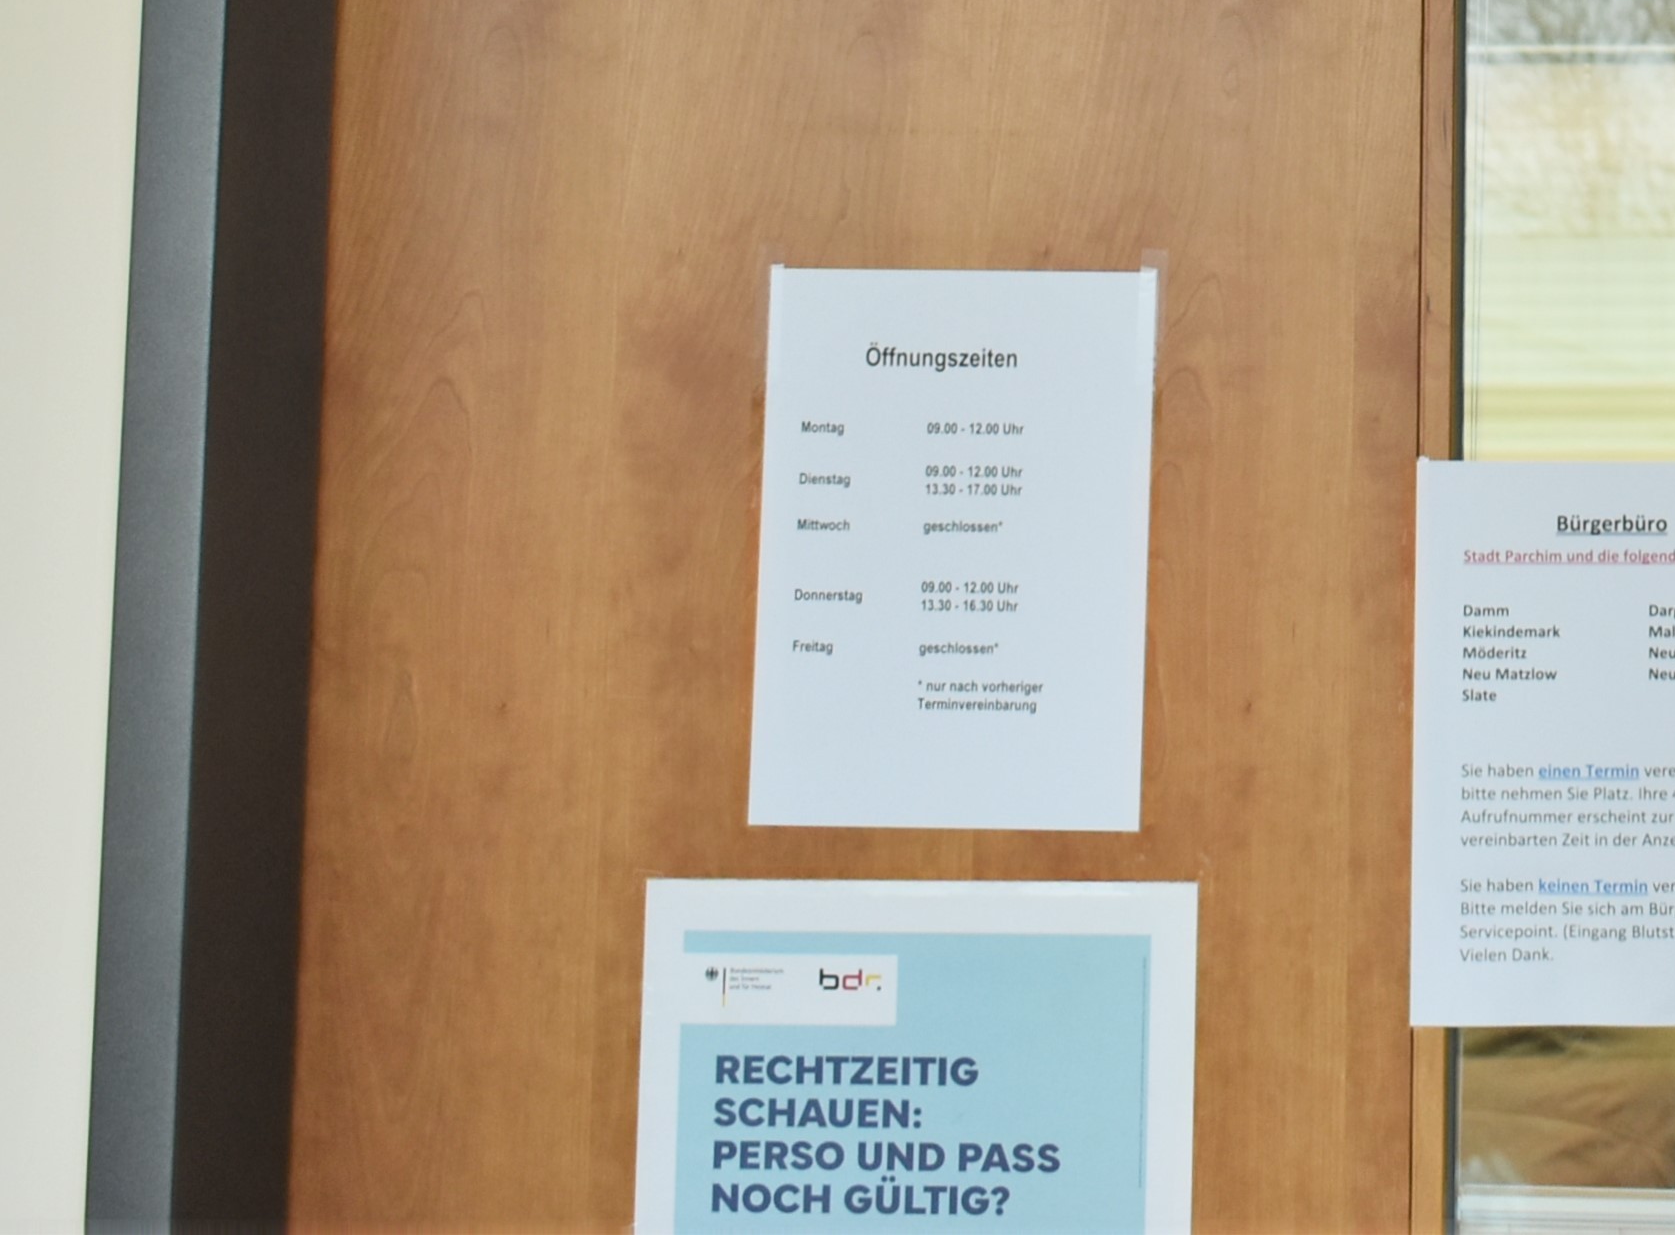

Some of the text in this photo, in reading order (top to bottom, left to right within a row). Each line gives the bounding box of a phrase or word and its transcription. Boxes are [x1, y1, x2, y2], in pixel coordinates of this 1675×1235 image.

[865, 342, 1017, 371] Öffnungszeiten
[801, 421, 844, 436] Montag
[927, 422, 958, 434] 09.00
[970, 423, 999, 435] 12.00
[1003, 423, 1024, 435] Uhr
[925, 465, 956, 477] 09.00
[968, 466, 998, 478] 12.00
[1001, 466, 1022, 478] Uhr
[799, 472, 851, 488] Dienstag
[926, 483, 956, 495] 13.30
[967, 484, 997, 496] 17.00
[1001, 484, 1022, 496] Uhr
[797, 519, 850, 531] Mittwoch
[1556, 514, 1667, 536] Bürgerbüro
[1463, 549, 1501, 565] Stadt
[1505, 549, 1563, 565] Parchim
[1566, 549, 1594, 565] und
[1597, 549, 1620, 565] die
[921, 581, 952, 593] 09.00
[964, 582, 994, 594] 12.00
[998, 582, 1019, 594] Uhr
[794, 588, 863, 604] Donnerstag
[921, 599, 952, 611] 13.30
[963, 600, 993, 612] 16.30
[997, 600, 1018, 612] Uhr
[1463, 604, 1509, 617] Damm
[1463, 625, 1560, 639] Kiekindemark
[792, 640, 833, 656] Freitag
[1463, 646, 1526, 660] Möderitz
[1463, 667, 1557, 681] Neu Matzlow
[926, 682, 946, 692] nur
[950, 680, 978, 692] nach
[982, 681, 1043, 695] vorheriger
[1462, 689, 1497, 702] Slate
[917, 698, 1037, 714] Terminvereinbarung
[1461, 764, 1483, 778] Sie
[1488, 763, 1534, 779] haben
[1538, 764, 1582, 780] einen
[1585, 764, 1639, 780] Termin
[1461, 787, 1496, 801] bitte
[1501, 787, 1562, 801] nehmen
[1567, 787, 1588, 801] Sie
[1594, 787, 1633, 801] Platz.
[1639, 787, 1668, 802] Ihre
[1460, 809, 1674, 824] Aufrufnummer erscheint zur
[1461, 833, 1557, 847] vereinbarten
[1562, 833, 1590, 847] Zeit
[1595, 833, 1608, 847] in
[1613, 833, 1637, 847] der
[1461, 879, 1482, 893] Sie
[1487, 878, 1533, 893] haben
[1538, 879, 1590, 896] keinen
[1593, 879, 1648, 896] Termin
[1461, 902, 1496, 916] Bitte
[1501, 901, 1557, 916] melden
[1562, 901, 1583, 916] Sie
[1588, 901, 1616, 916] sich
[1621, 905, 1644, 917] am
[1460, 925, 1557, 941] Servicepoint.
[1563, 924, 1627, 942] (Eingang
[1460, 948, 1553, 962] Vielen Dank.
[715, 1055, 979, 1087] RECHTZEITIG
[714, 1097, 922, 1129] SCHAUEN:
[713, 1140, 1061, 1174] PERSO UND PASS
[711, 1175, 1010, 1216] NOCH GÜLTIG?
